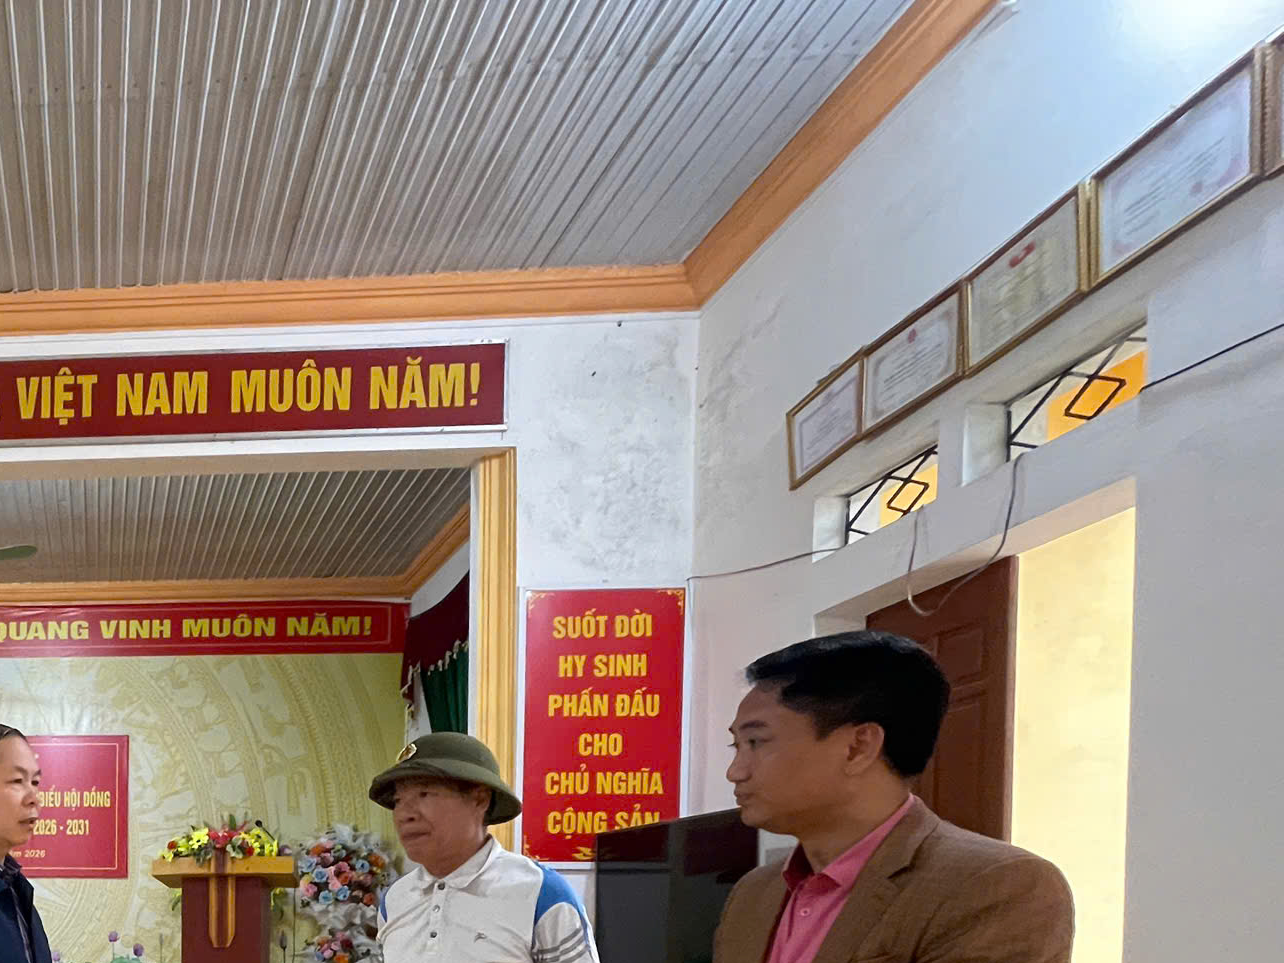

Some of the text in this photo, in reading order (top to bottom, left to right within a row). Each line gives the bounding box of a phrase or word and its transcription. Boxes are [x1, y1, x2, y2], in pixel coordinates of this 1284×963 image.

[17, 366, 98, 426] VIỆT
[117, 371, 209, 417] NAM
[231, 359, 352, 414] MUÔN
[370, 356, 482, 410] NĂM!
[100, 619, 171, 640] VINH
[182, 613, 276, 639] MUÔN
[287, 612, 372, 637] NĂM!
[552, 607, 608, 640] SUỐT
[558, 653, 647, 678] HY SINH
[547, 685, 660, 718] PHẤN ĐẤU
[578, 732, 623, 757] CHO
[545, 763, 665, 796] CHỦ NGHĨA
[64, 787, 80, 811] HỘI
[33, 819, 57, 835] 2026
[66, 819, 90, 836] 2031
[547, 806, 608, 841] CỘNG
[24, 849, 46, 859] 2026
